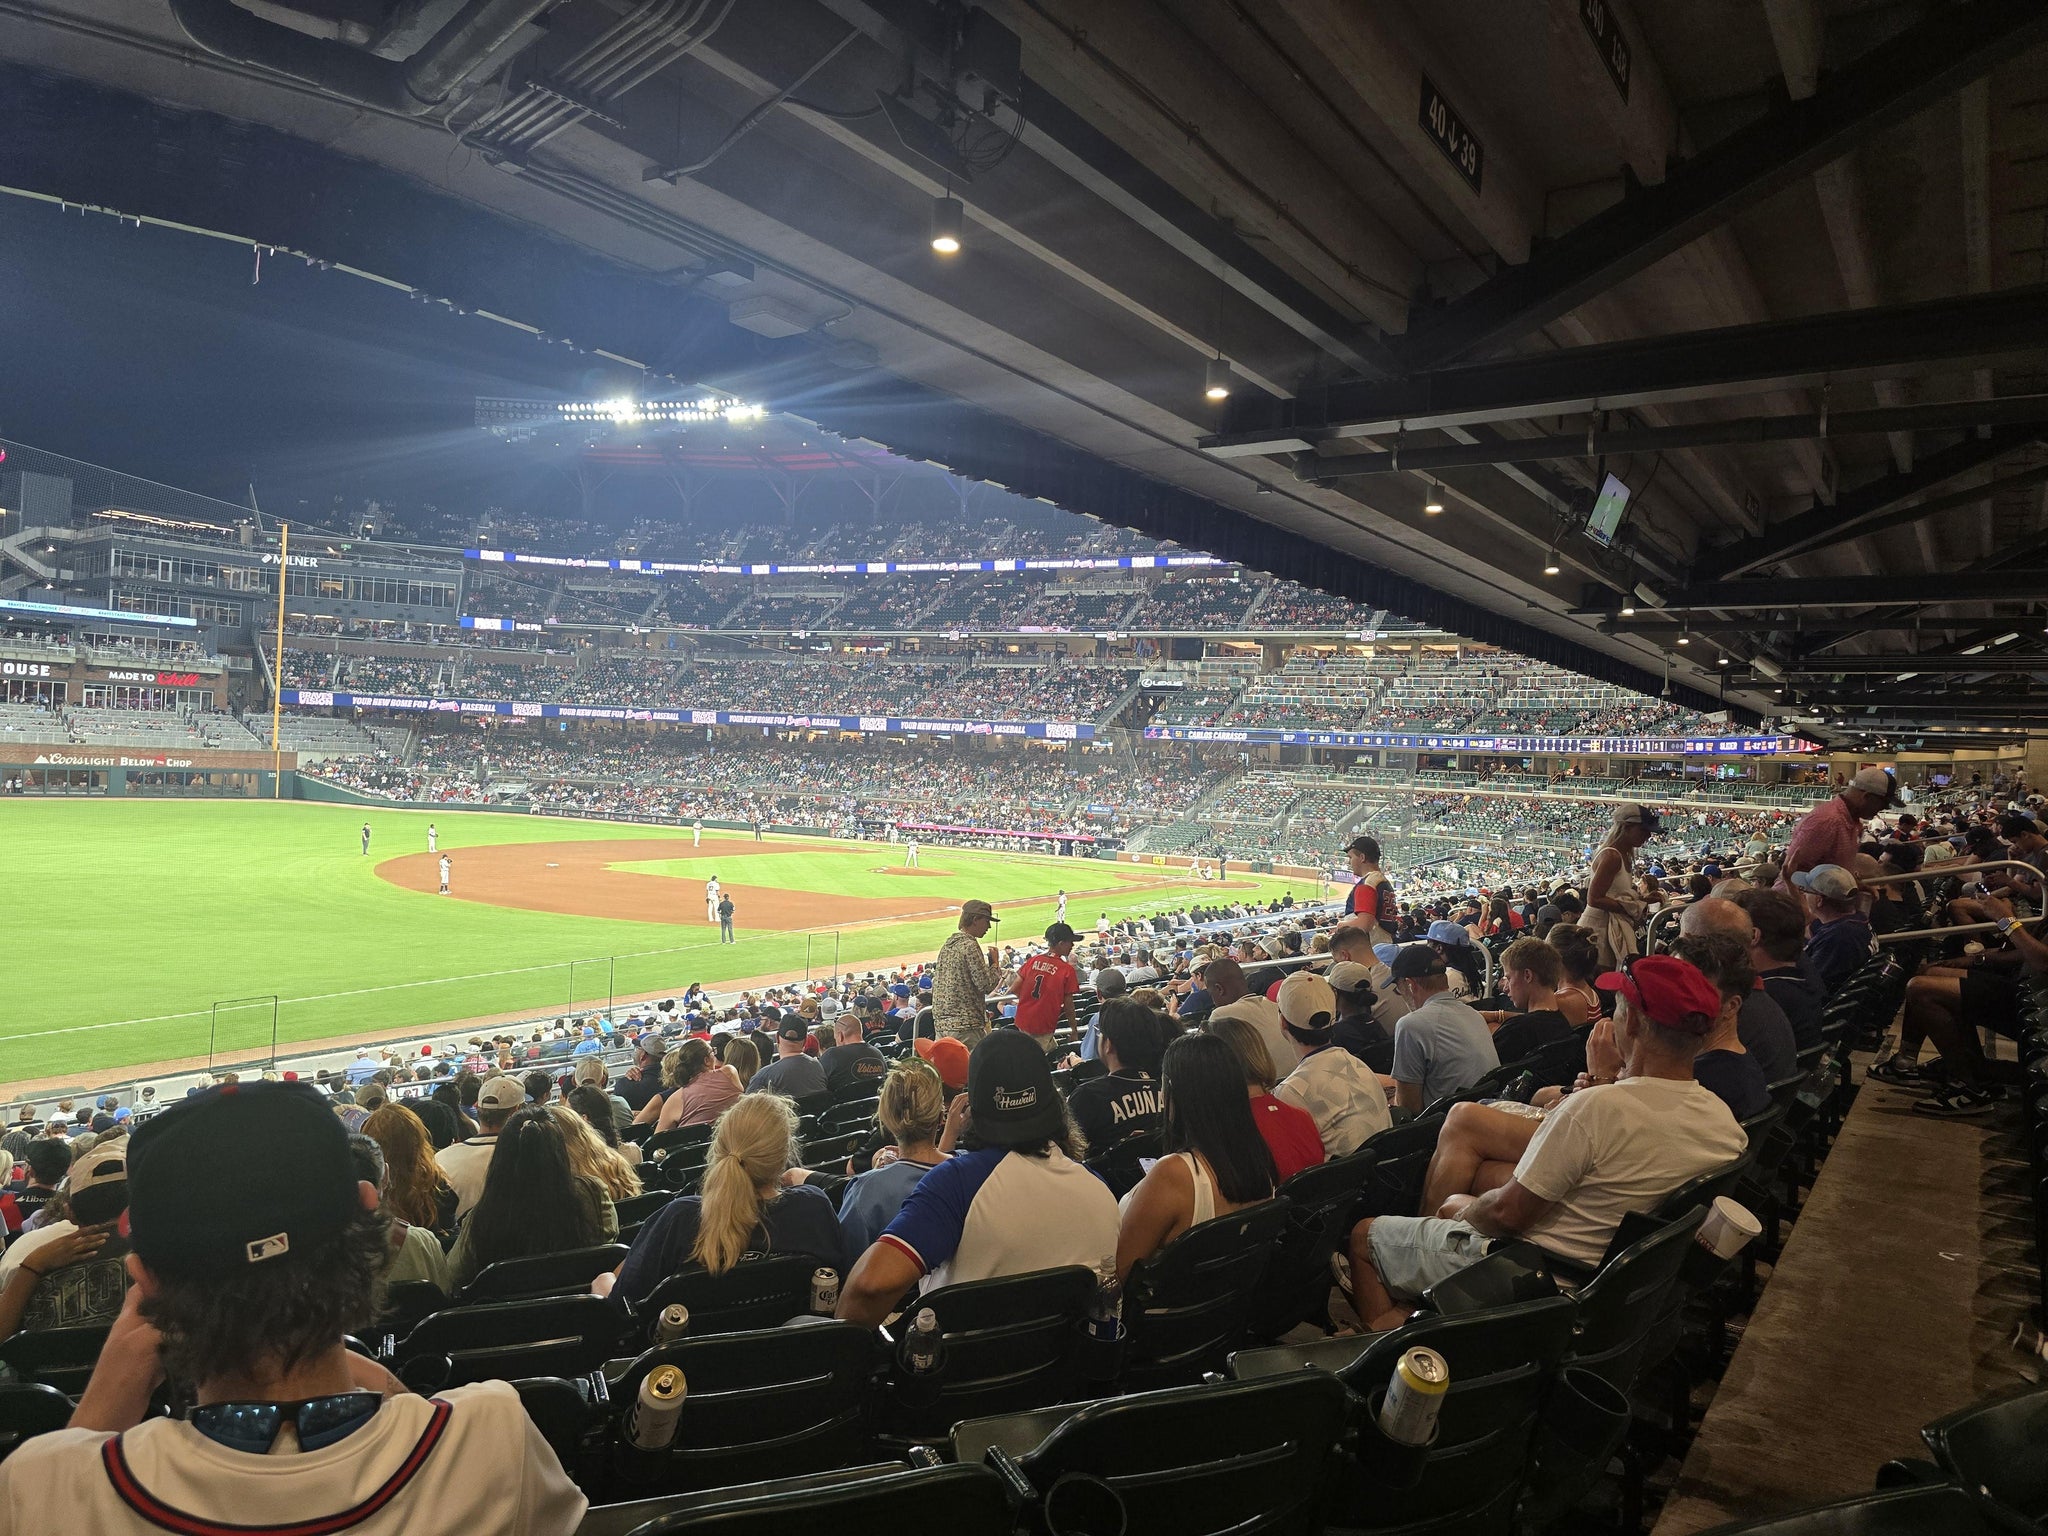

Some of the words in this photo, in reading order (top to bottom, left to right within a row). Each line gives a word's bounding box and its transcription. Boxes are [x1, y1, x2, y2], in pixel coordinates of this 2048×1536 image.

[1429, 95, 1446, 138] 40
[1461, 133, 1475, 175] 39
[109, 671, 139, 680] MADE
[141, 673, 155, 682] TO
[352, 697, 371, 706] YOUR
[372, 698, 387, 706] NEW
[389, 698, 412, 707] HOME
[412, 699, 428, 708] FOR
[461, 703, 496, 712] BASEBALL
[559, 707, 575, 716] YOUR
[610, 709, 624, 718] FOR
[653, 712, 679, 721] BASEBALL
[993, 725, 1025, 734] BASEBALL
[1188, 731, 1213, 739] CARLOS
[1213, 732, 1247, 740] CARRASCO
[85, 758, 115, 766] LIGHT
[120, 757, 154, 767] BELOW
[166, 758, 192, 767] CHOP
[1031, 960, 1058, 976] ALBIES
[1031, 974, 1044, 999] 1
[1000, 1091, 1036, 1109] Hawaii
[1110, 1085, 1166, 1124] ACUÑA
